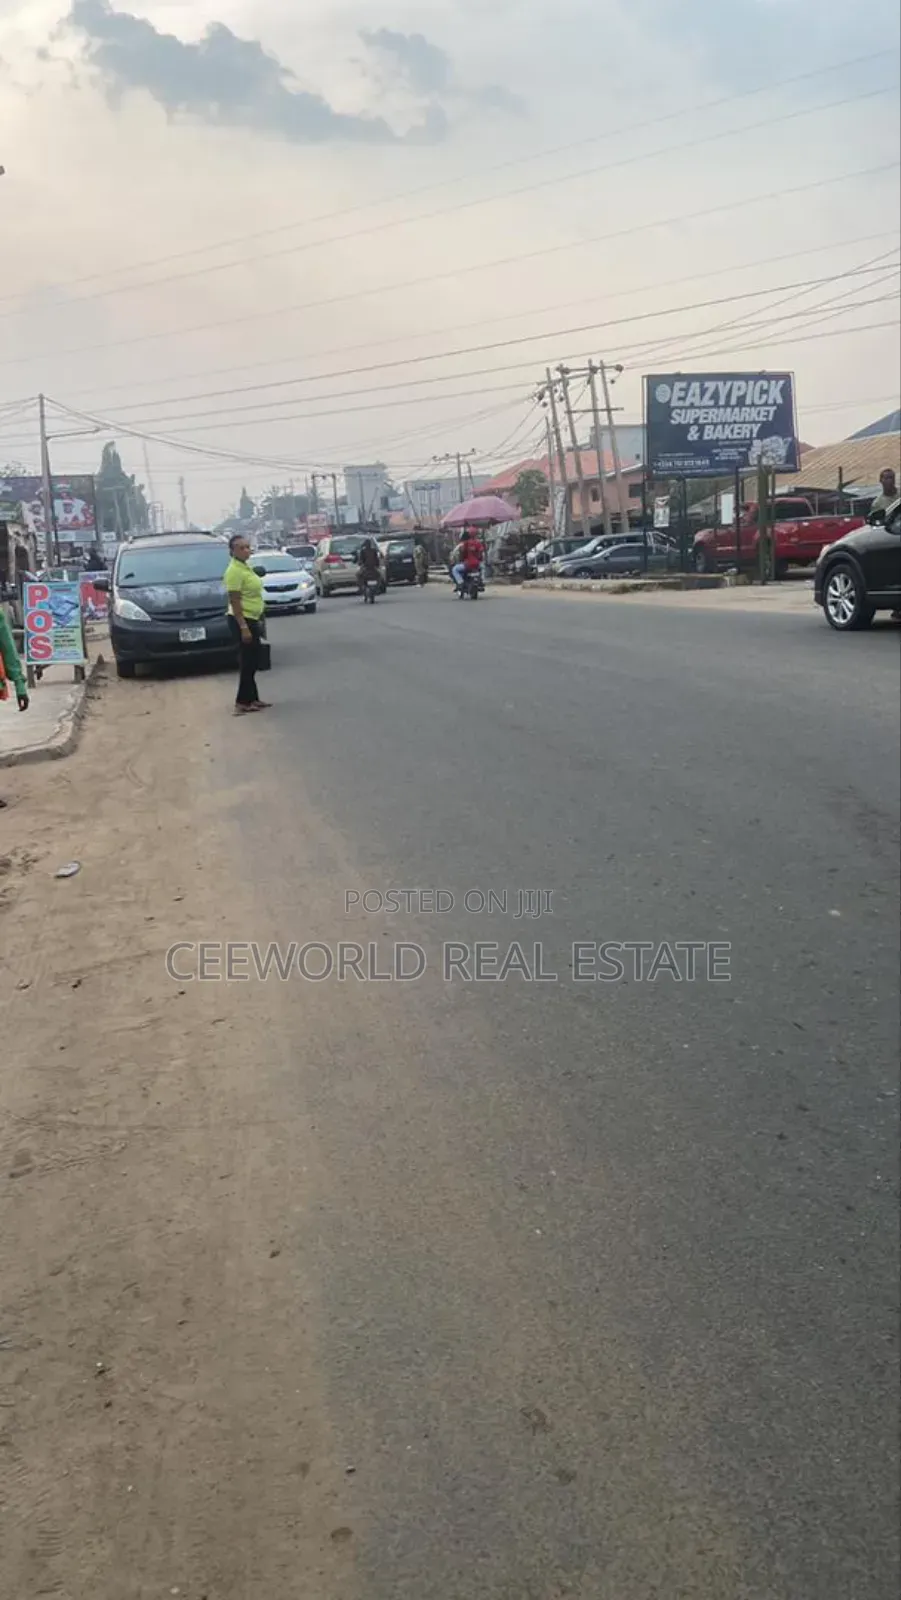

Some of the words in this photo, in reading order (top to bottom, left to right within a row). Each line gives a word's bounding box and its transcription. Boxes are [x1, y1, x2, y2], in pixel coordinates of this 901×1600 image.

[670, 380, 785, 406] EAZYPICK
[671, 407, 776, 424] SUPERMARKET
[688, 425, 700, 441] &
[704, 424, 761, 440] BAKERY
[26, 585, 53, 659] POS
